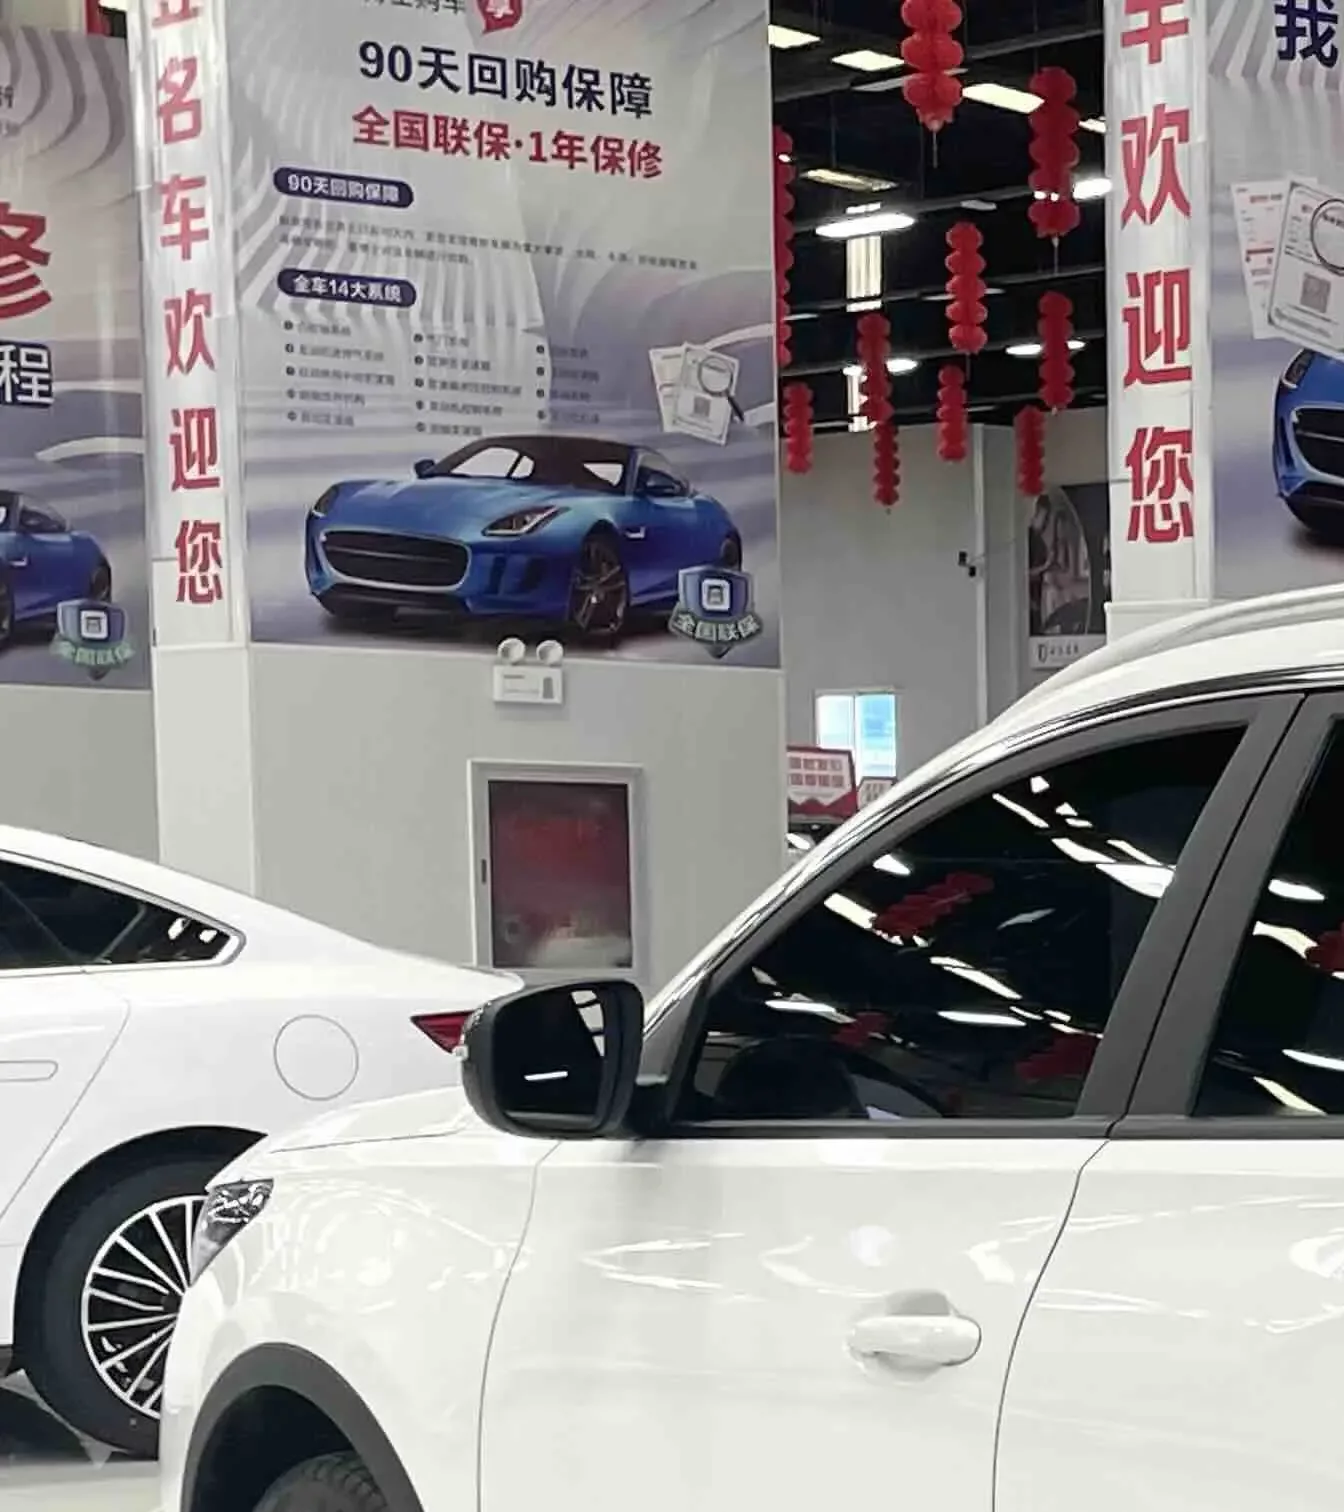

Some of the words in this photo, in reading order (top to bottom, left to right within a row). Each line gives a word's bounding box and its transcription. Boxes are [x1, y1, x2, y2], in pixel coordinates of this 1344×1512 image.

[358, 40, 654, 120] 90天回购保障
[351, 104, 663, 180] 全国联保·1年保修
[286, 172, 400, 205] 90天回购保障
[292, 273, 401, 304] 全车14大系统
[671, 612, 762, 642] 全国联保
